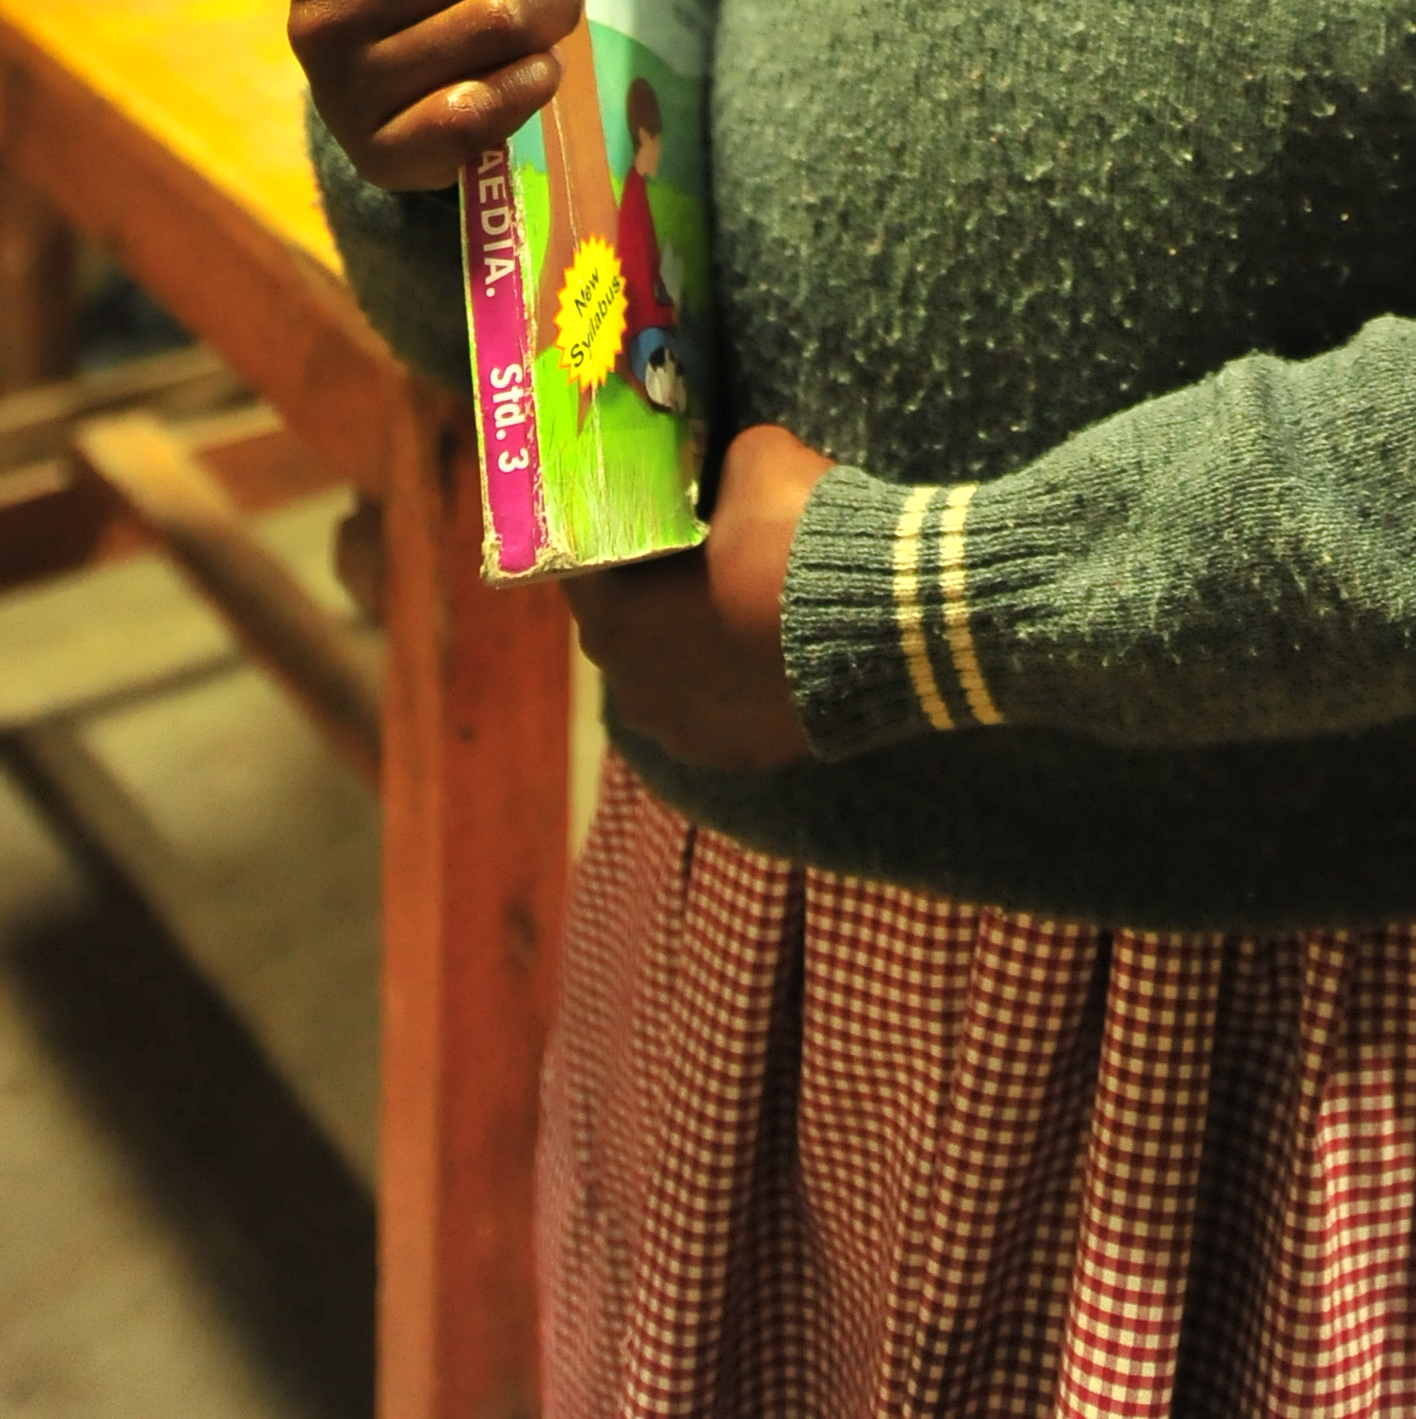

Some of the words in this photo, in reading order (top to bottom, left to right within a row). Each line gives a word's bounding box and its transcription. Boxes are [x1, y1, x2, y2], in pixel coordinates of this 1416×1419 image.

[476, 149, 516, 298] AEDIA.
[574, 266, 600, 318] New
[490, 363, 525, 442] Std.
[497, 447, 530, 474] 3
